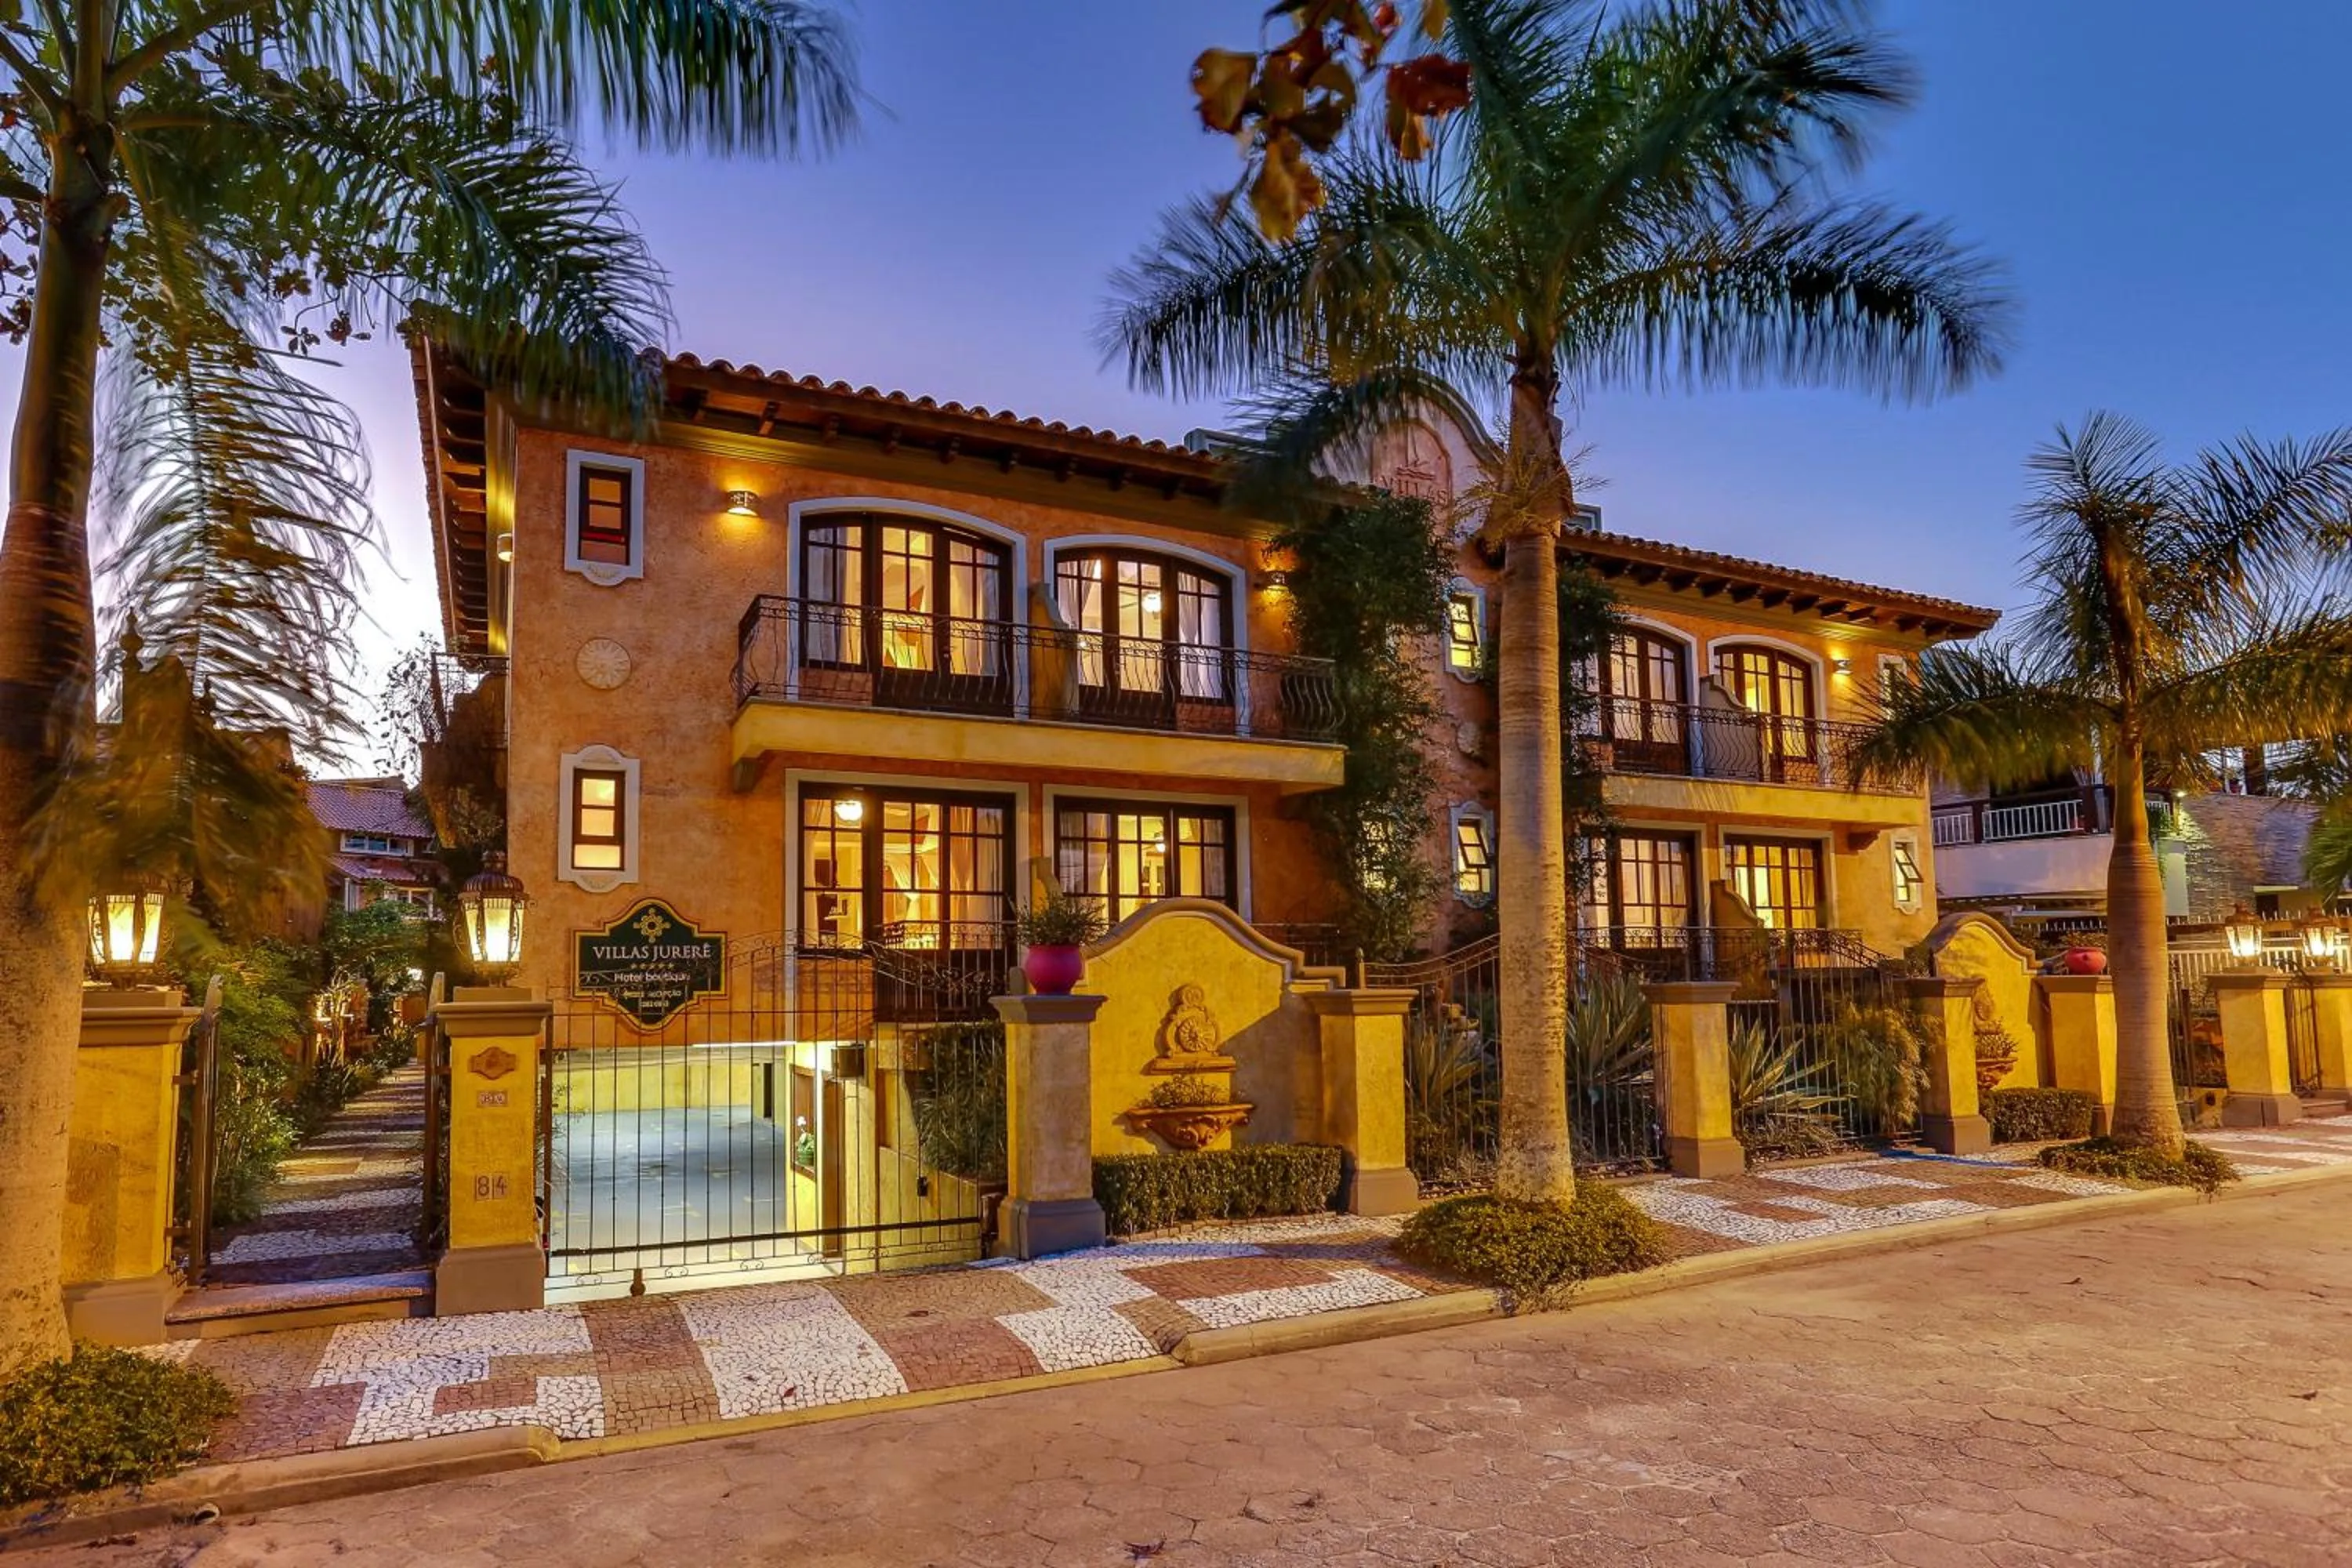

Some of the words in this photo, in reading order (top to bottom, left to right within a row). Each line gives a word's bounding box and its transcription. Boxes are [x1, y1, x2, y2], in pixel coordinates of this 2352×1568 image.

[592, 946, 649, 959] VILLAS
[652, 942, 712, 961] JURERÊ
[614, 971, 643, 982] Hotel
[477, 1174, 508, 1196] 84
